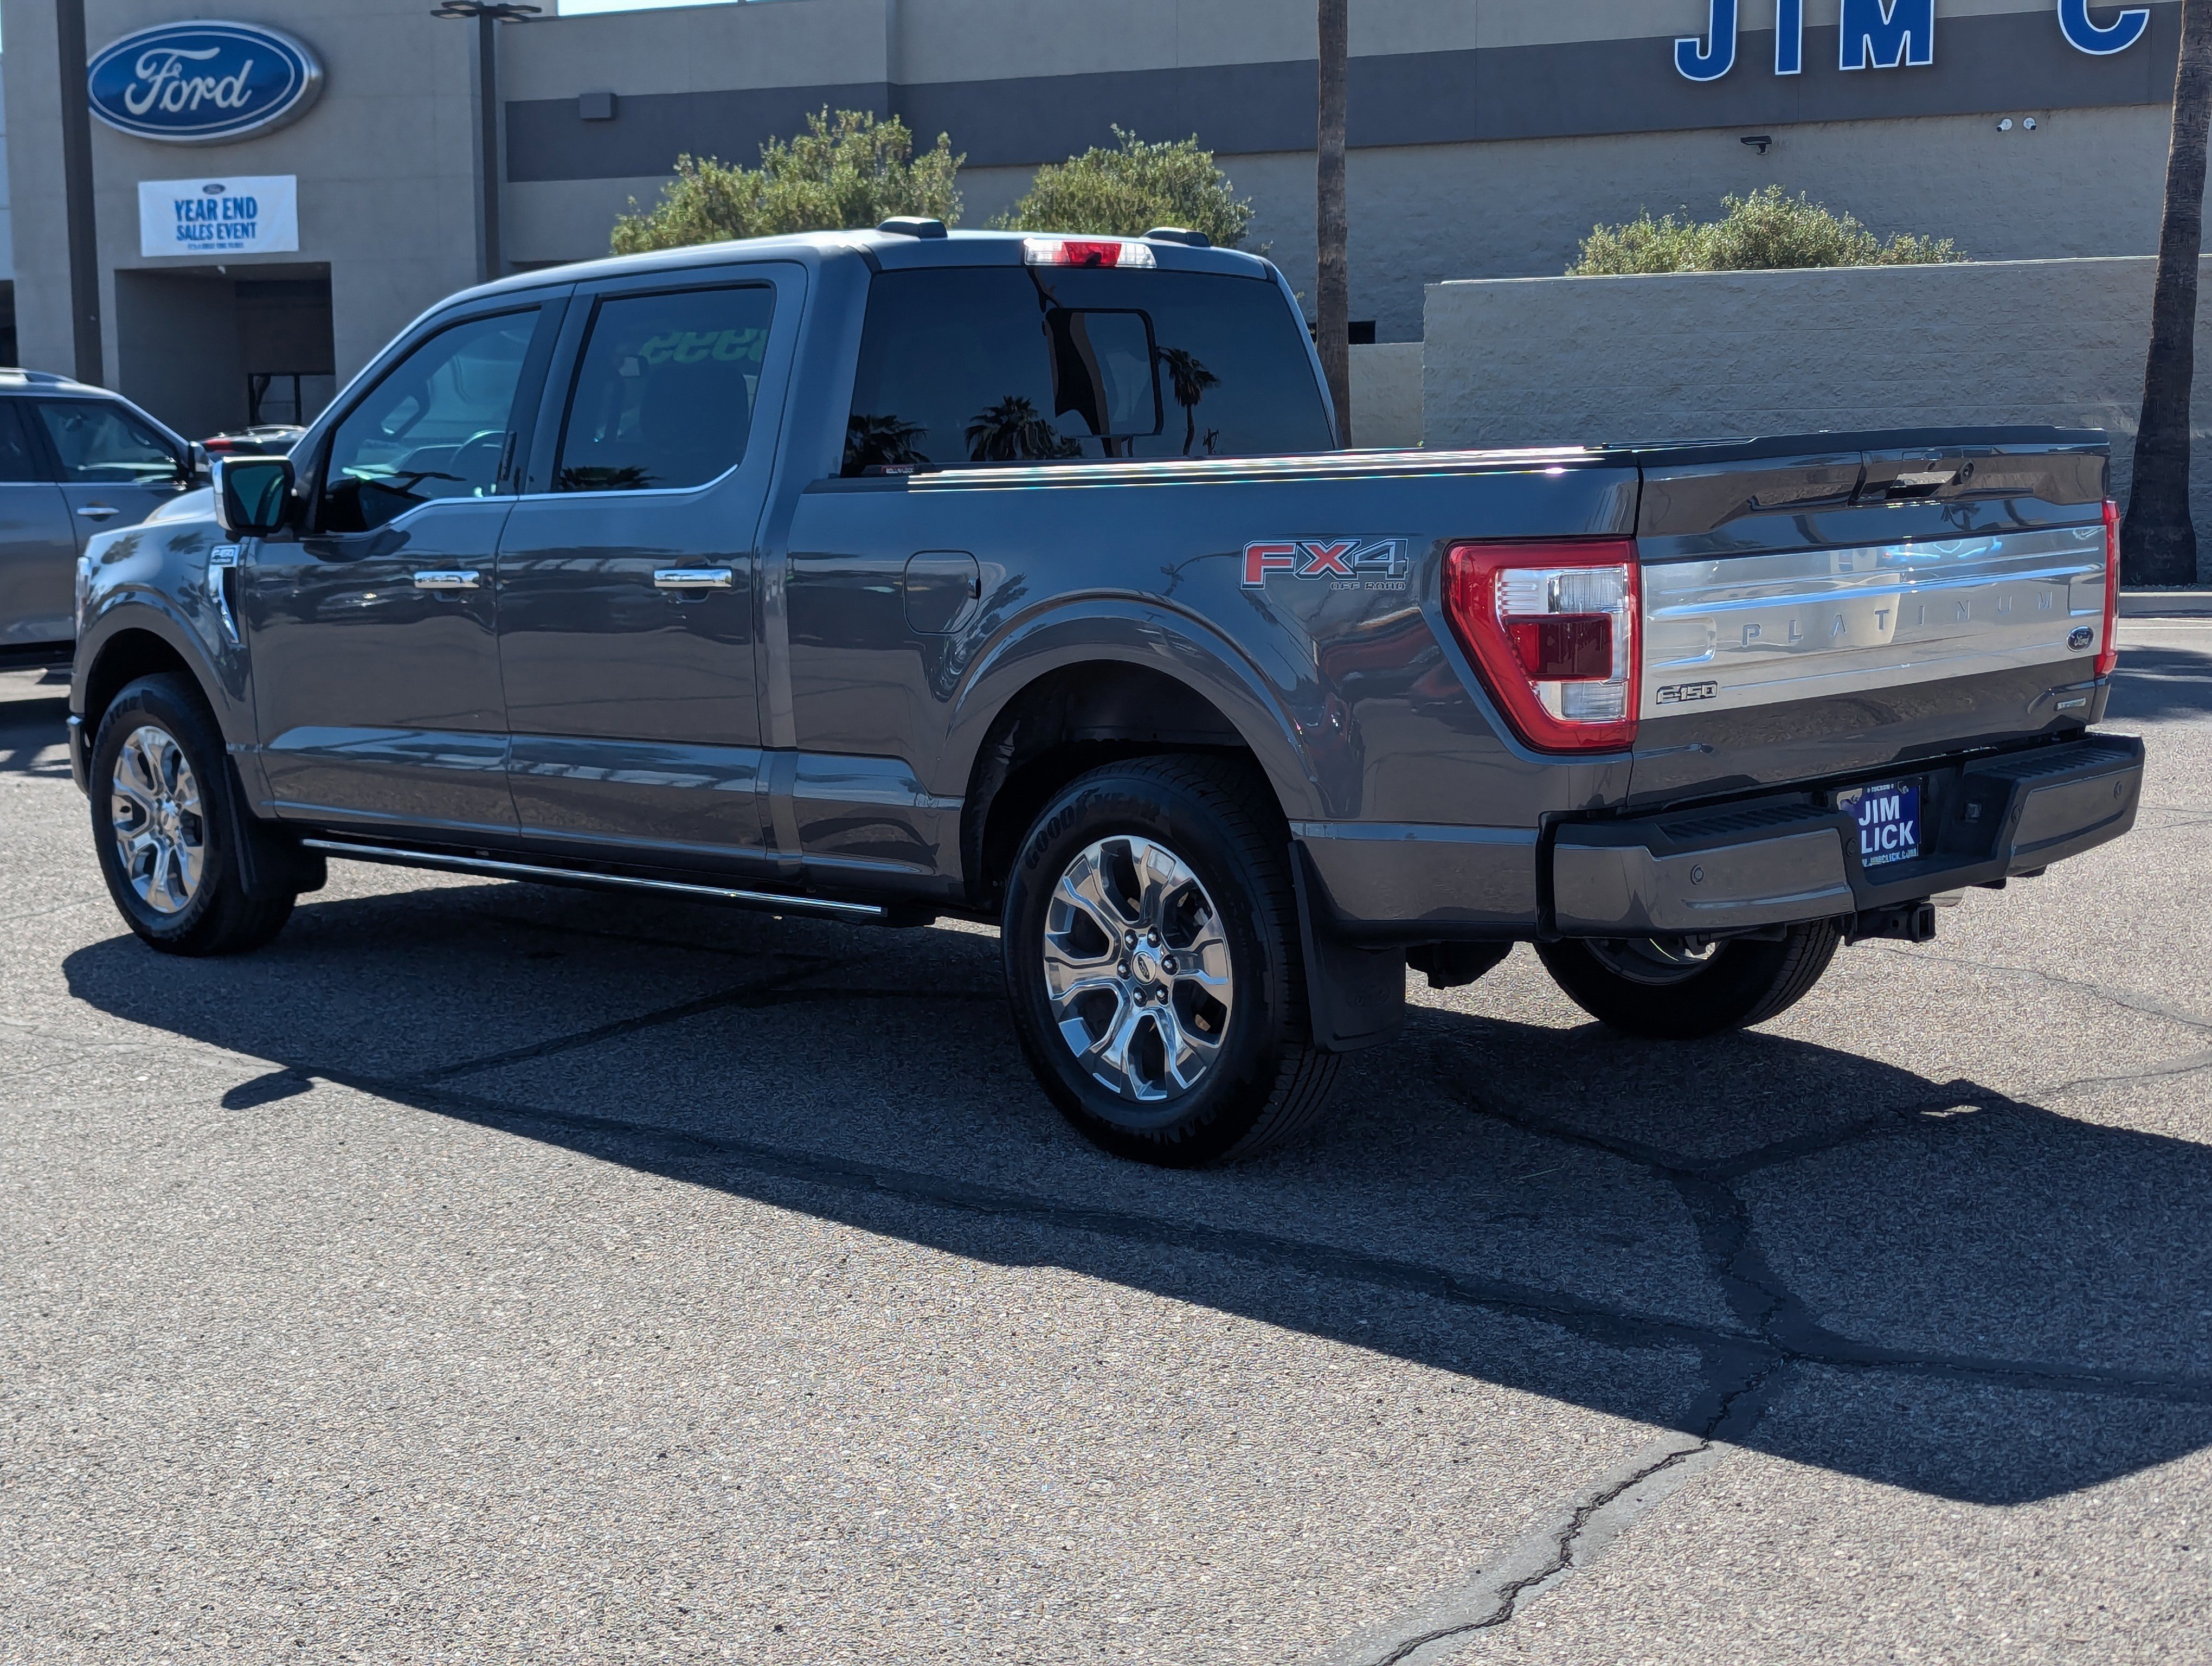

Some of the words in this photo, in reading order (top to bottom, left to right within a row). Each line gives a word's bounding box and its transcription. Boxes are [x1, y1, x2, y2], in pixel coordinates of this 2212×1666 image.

[1675, 0, 1934, 81] JIM
[125, 47, 254, 115] Ford
[175, 198, 217, 222] YEAR
[223, 196, 258, 220] END
[176, 223, 214, 241] SALES
[217, 222, 257, 240] EVENT
[1240, 539, 1409, 589] FX4
[1330, 581, 1360, 591] OFF
[1365, 581, 1406, 591] ROAD
[1741, 591, 2053, 648] PLATINUM
[1858, 795, 1900, 826] JIM
[1861, 821, 1915, 854] LICK
